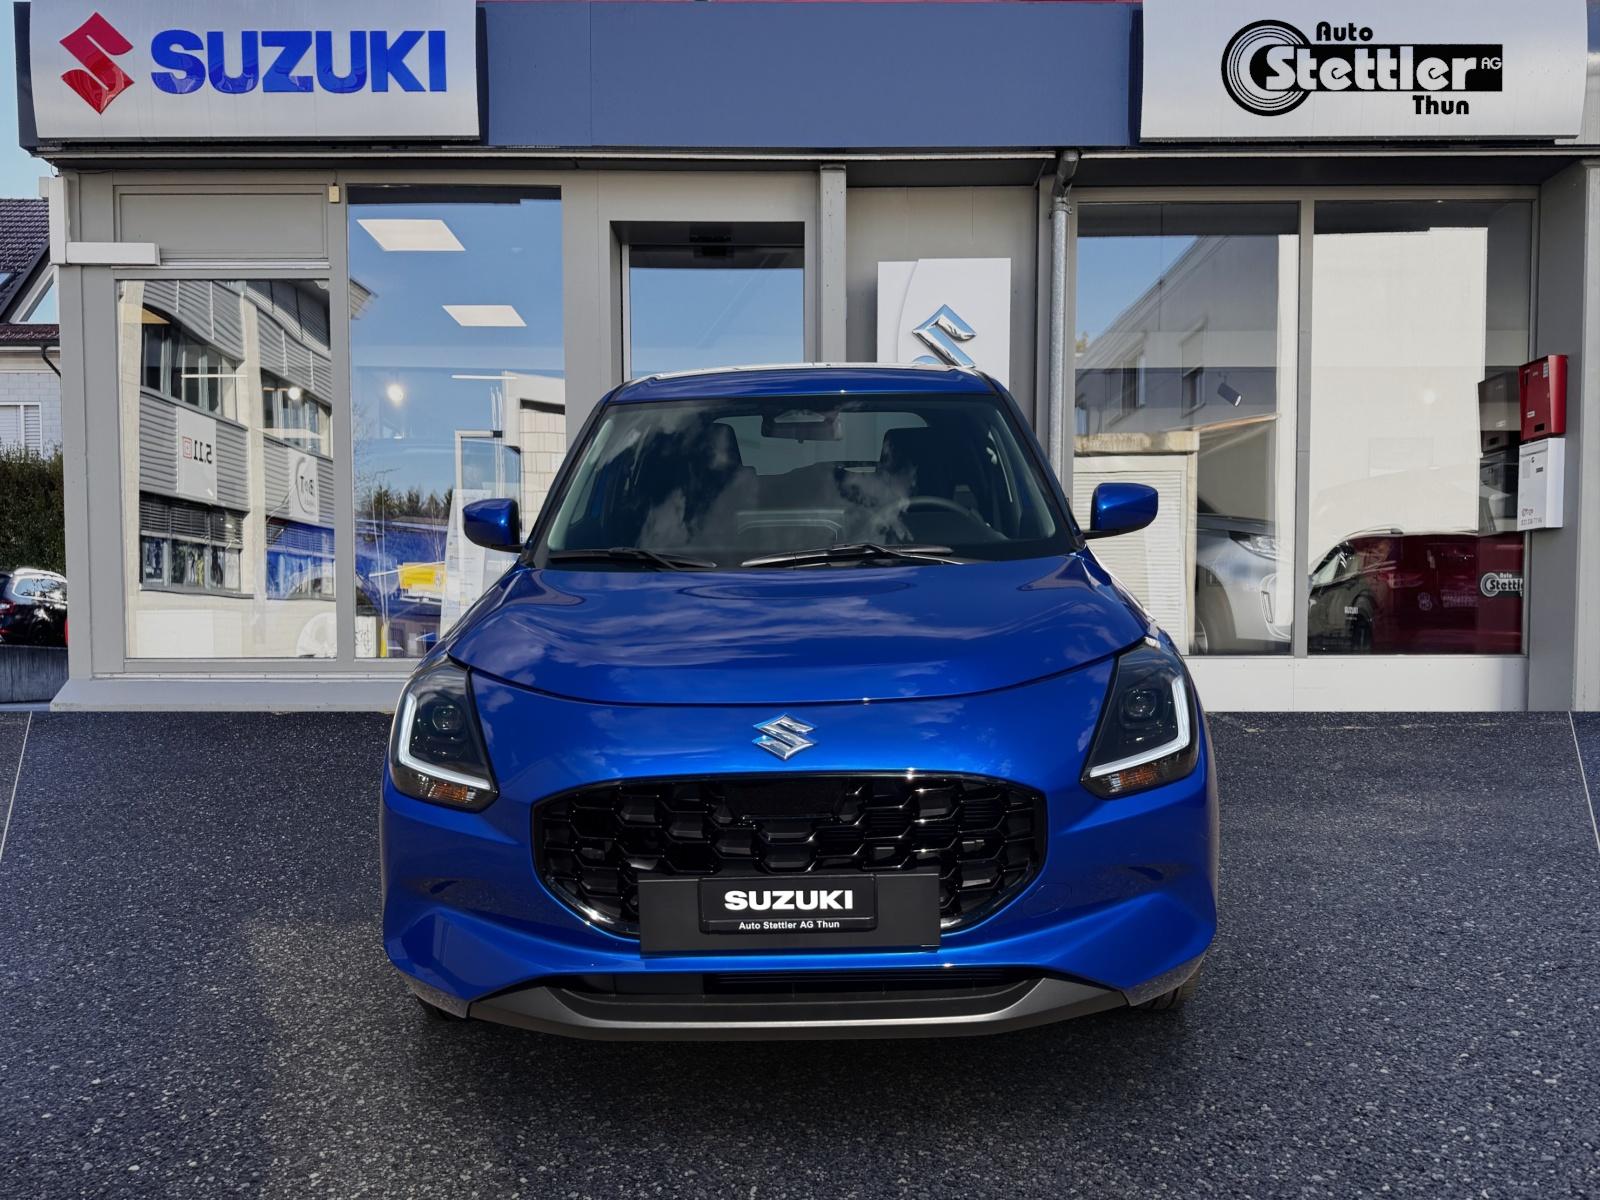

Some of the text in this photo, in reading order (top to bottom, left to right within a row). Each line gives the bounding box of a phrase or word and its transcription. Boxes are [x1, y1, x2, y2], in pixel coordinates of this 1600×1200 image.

[1316, 21, 1373, 41] Auto
[151, 29, 447, 94] SUZUKI
[1265, 45, 1502, 91] Stettler AG
[1412, 94, 1470, 115] Thun
[724, 890, 853, 911] SUZUKI
[738, 920, 840, 930] Auto Stettler AG Thun
